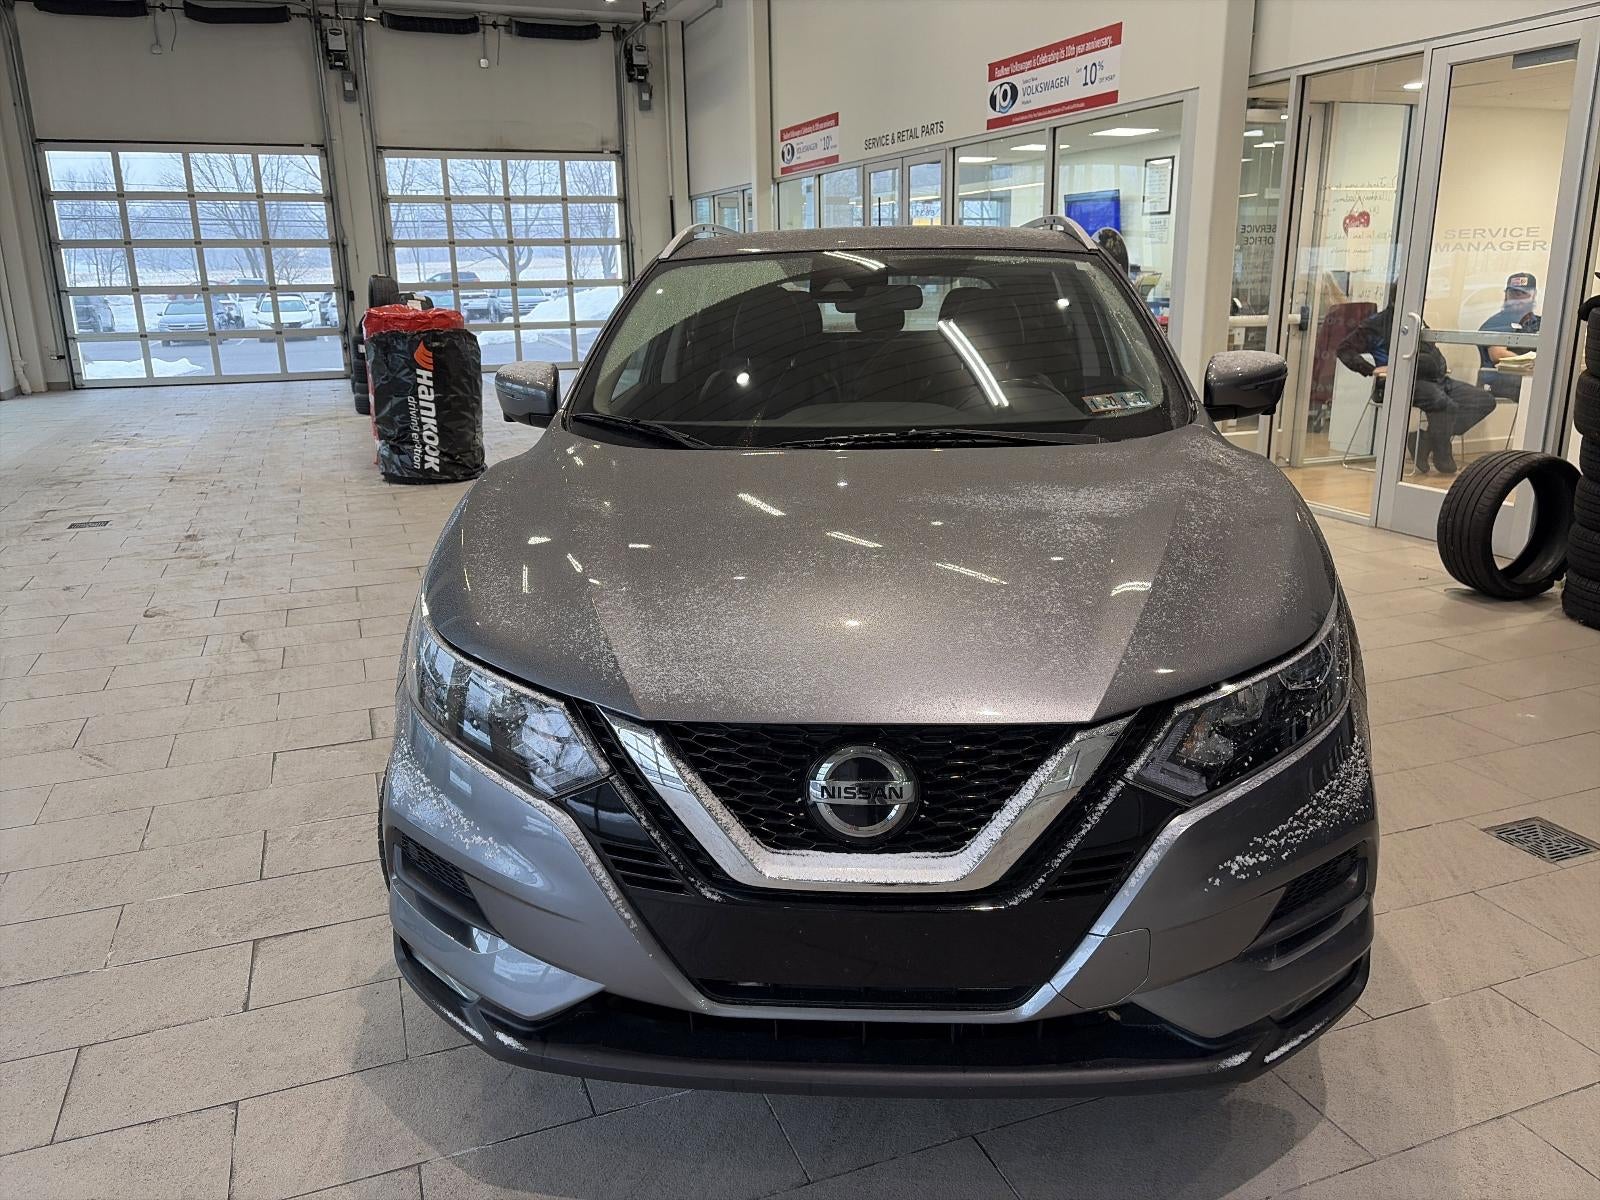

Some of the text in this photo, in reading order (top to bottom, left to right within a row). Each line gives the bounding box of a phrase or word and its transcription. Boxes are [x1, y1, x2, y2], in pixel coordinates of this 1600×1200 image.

[1010, 59, 1033, 74] Volkswagen
[1036, 49, 1059, 66] Celebrating
[1066, 44, 1076, 57] 10th
[1075, 44, 1086, 57] year
[993, 83, 1012, 113] 10
[1021, 75, 1070, 97] VOLKSWAGEN
[864, 120, 944, 151] SERVICE & RETAIL PARTS
[1434, 240, 1548, 253] MANAGER
[1443, 226, 1541, 240] SERVICE
[407, 395, 419, 431] driving
[416, 369, 440, 472] Hankook
[820, 784, 904, 799] NISSAN
